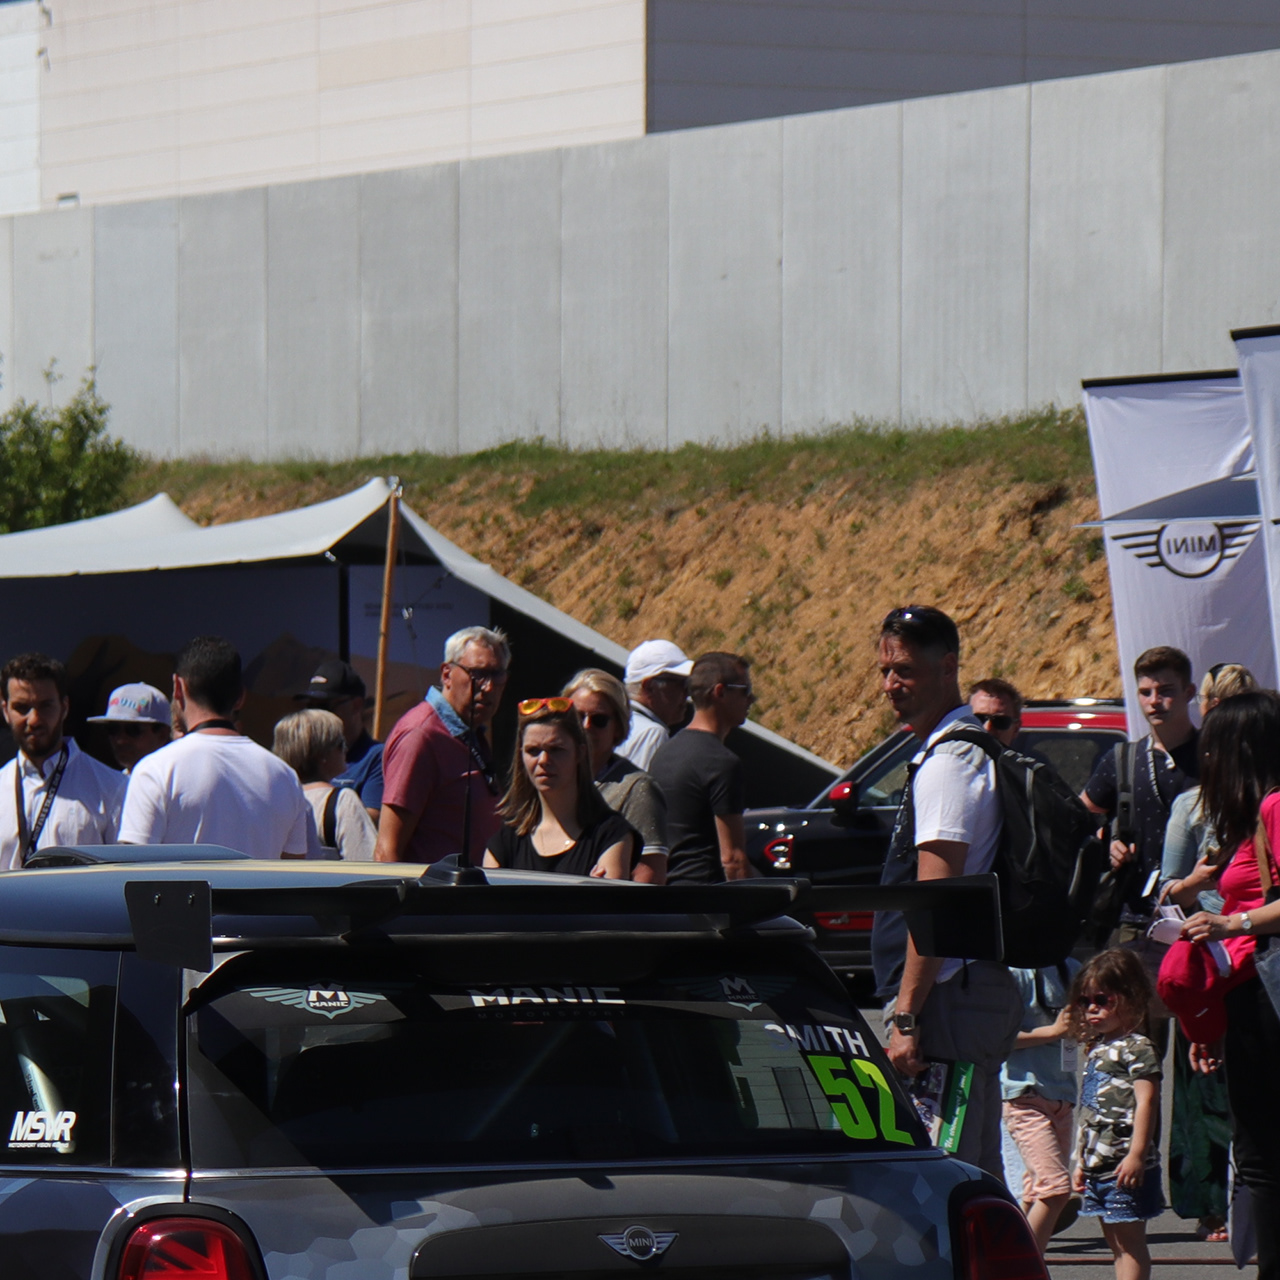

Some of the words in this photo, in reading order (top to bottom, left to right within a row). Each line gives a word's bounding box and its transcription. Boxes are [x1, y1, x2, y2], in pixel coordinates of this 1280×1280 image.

[466, 986, 627, 1007] MANIC
[764, 1024, 870, 1057] SMITH
[807, 1055, 916, 1146] 52
[10, 1111, 76, 1141] MSVR
[629, 1237, 653, 1248] MINI
